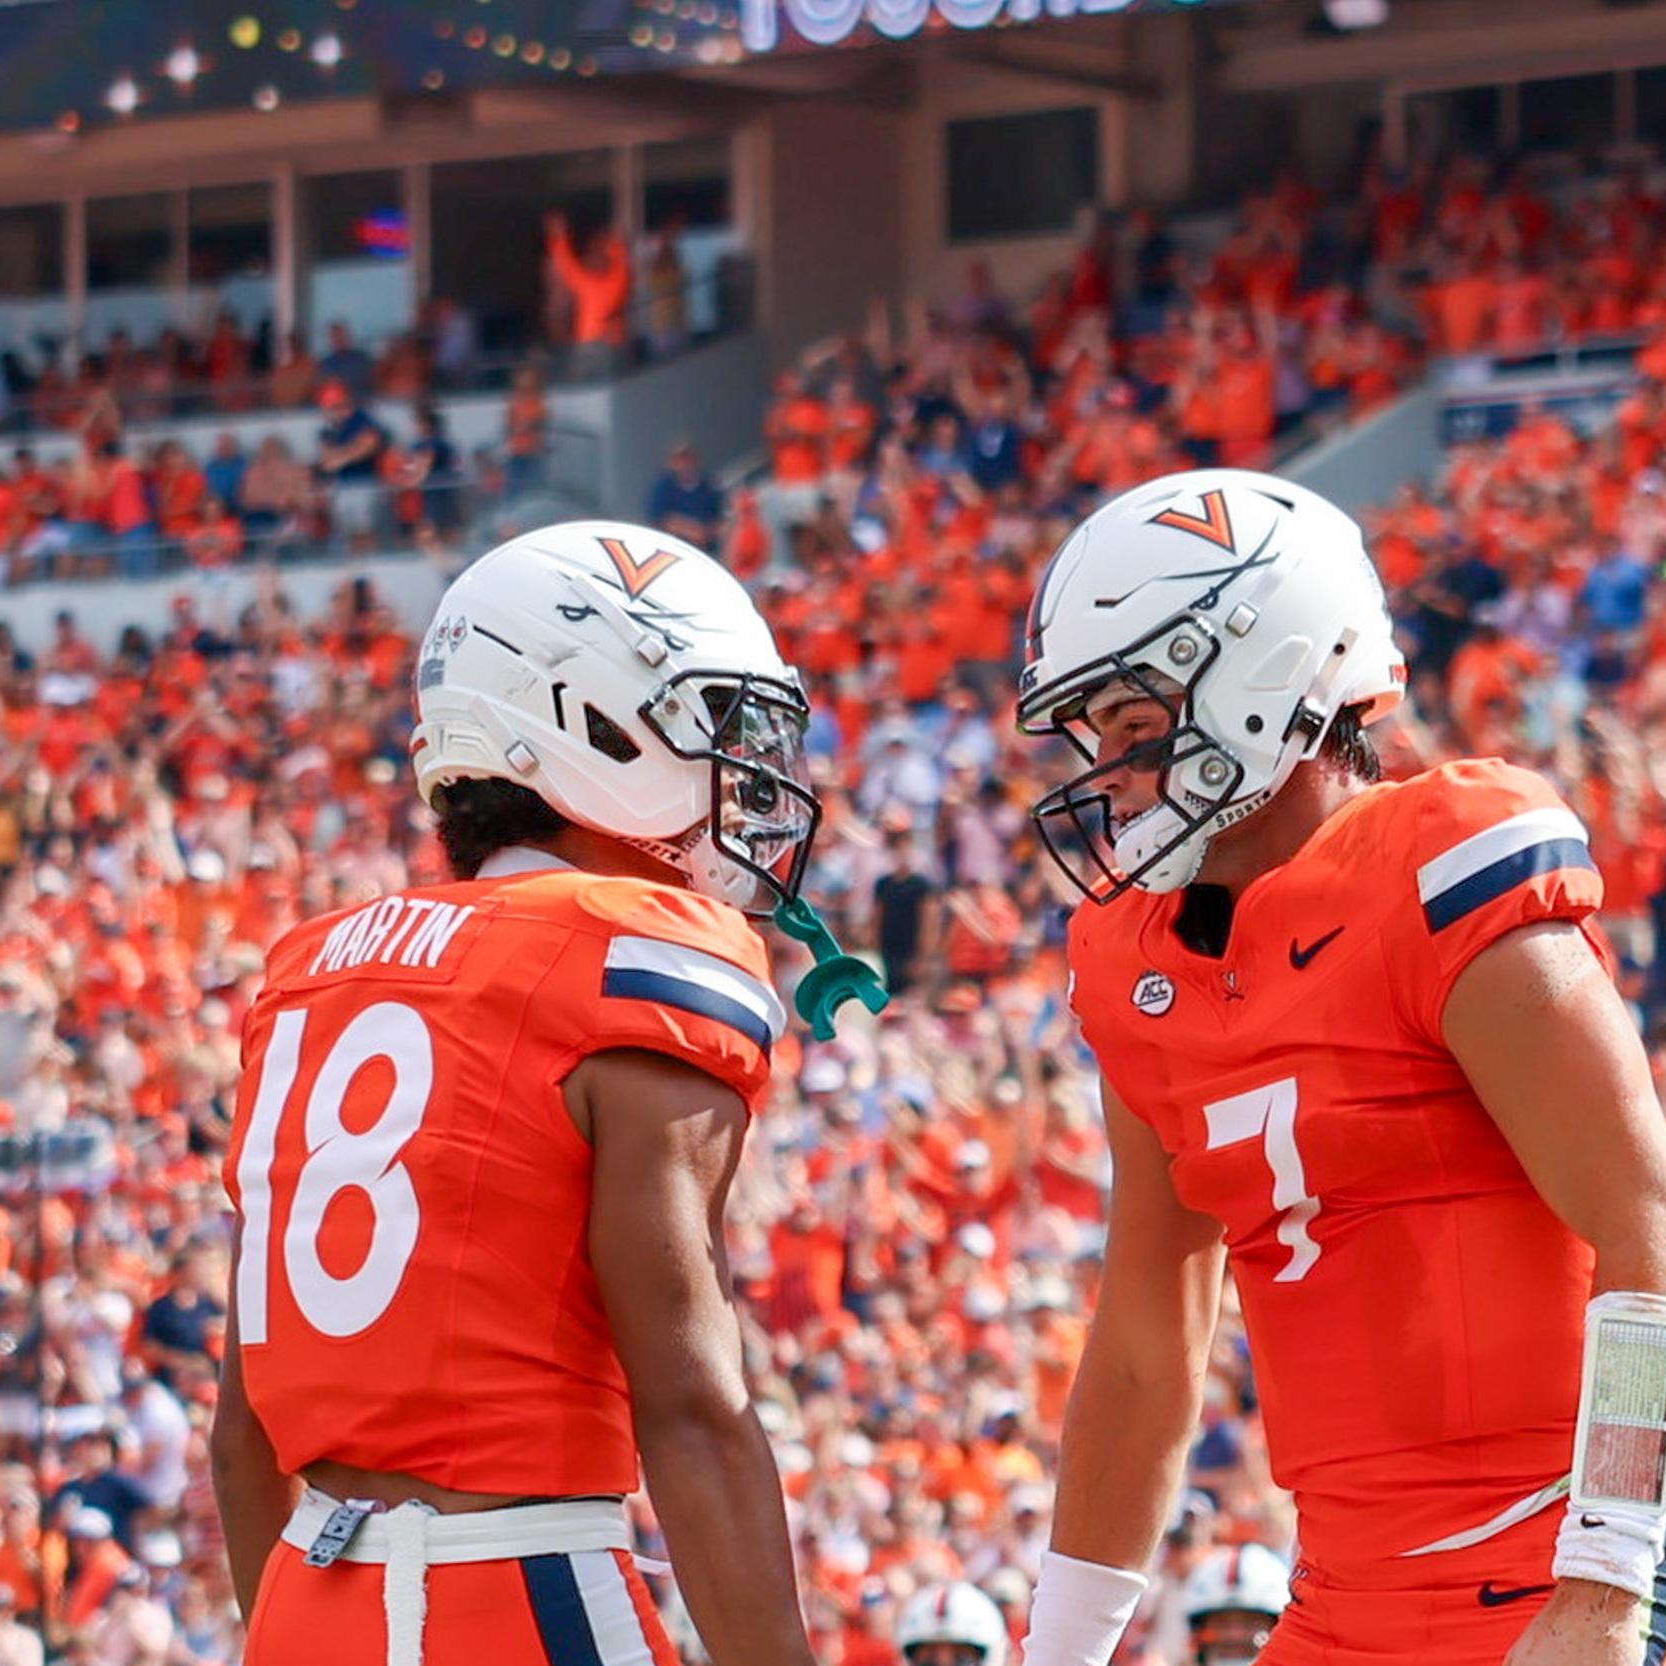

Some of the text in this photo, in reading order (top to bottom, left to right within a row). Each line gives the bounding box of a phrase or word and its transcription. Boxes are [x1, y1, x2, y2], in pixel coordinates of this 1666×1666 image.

[309, 896, 475, 977] MARTIN
[1139, 979, 1168, 1002] ACC
[237, 1002, 434, 1345] 18
[1202, 1077, 1321, 1283] 7
